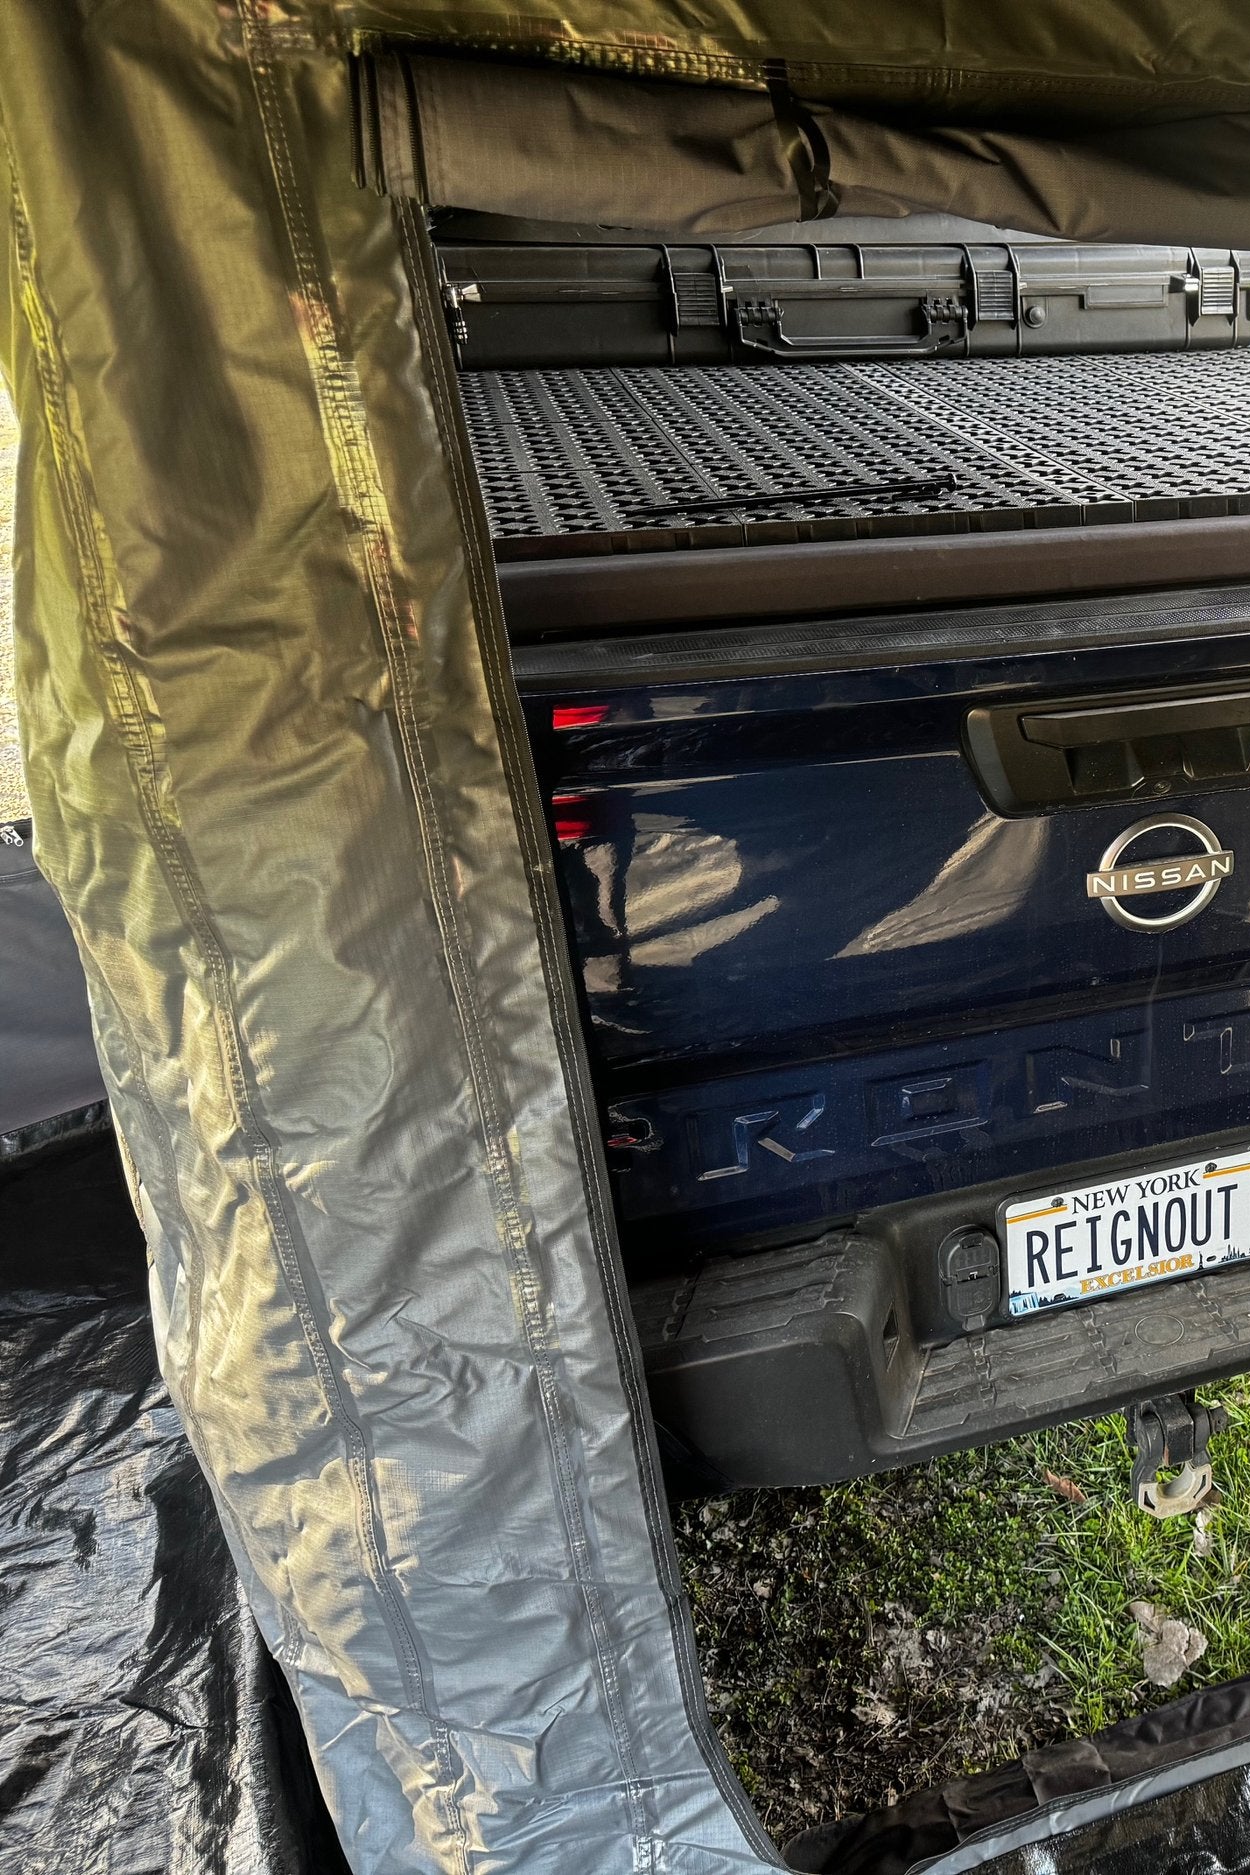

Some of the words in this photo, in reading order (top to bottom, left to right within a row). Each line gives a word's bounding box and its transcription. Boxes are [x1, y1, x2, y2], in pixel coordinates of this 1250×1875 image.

[1092, 856, 1231, 894] NISSAN
[1071, 1184, 1129, 1215] NEW
[1135, 1167, 1202, 1200] YORK
[1025, 1183, 1238, 1288] REIGNOUT
[1079, 1253, 1195, 1295] EXCELSIOR
